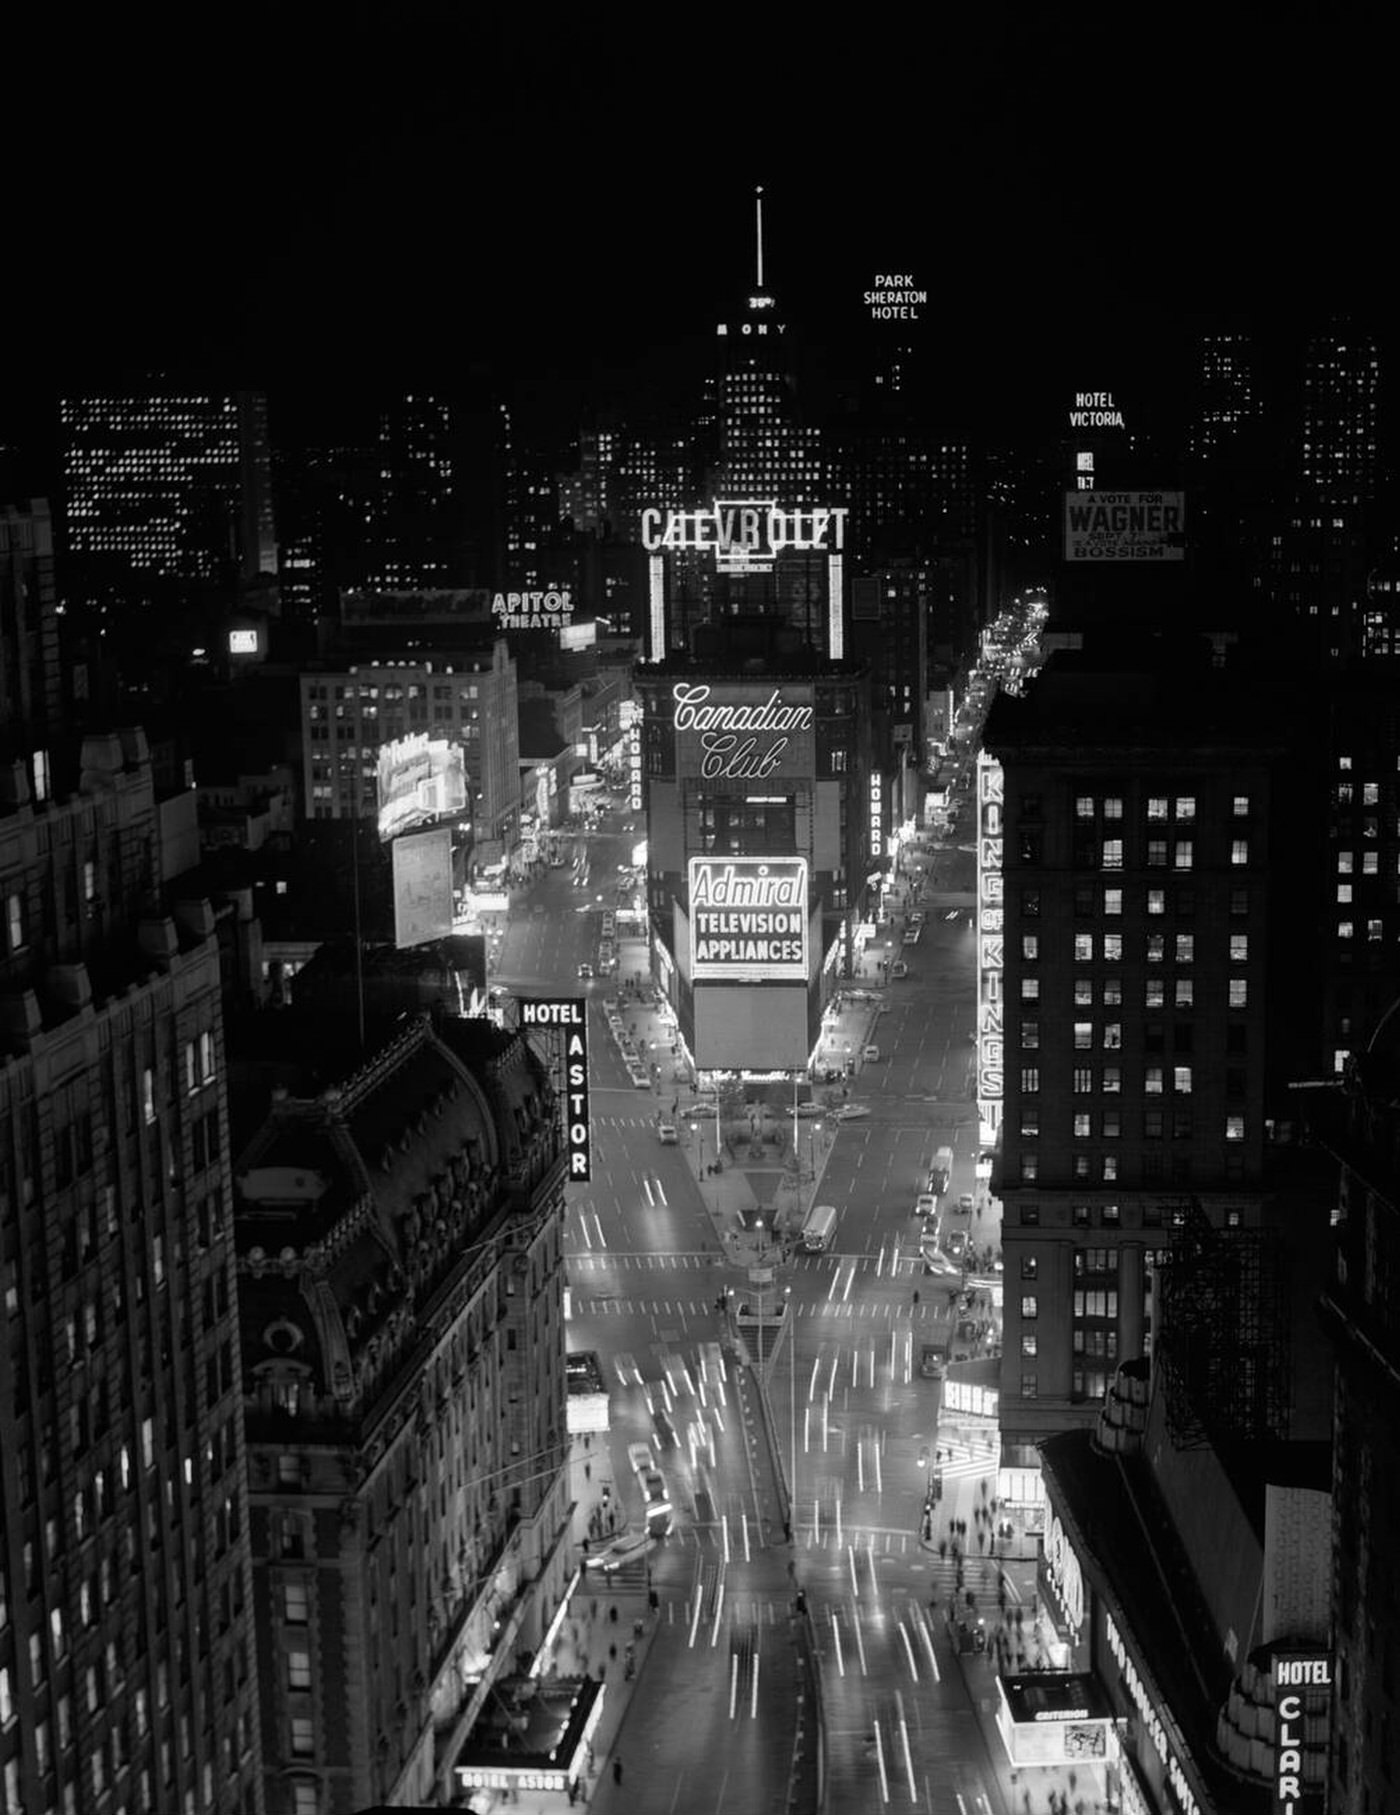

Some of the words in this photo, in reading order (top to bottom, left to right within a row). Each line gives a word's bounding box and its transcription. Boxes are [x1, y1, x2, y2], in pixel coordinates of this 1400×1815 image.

[875, 275, 914, 287] PARK
[863, 290, 927, 304] SHERATON
[871, 306, 919, 319] HOTEL
[717, 324, 786, 335] MONY
[1076, 392, 1115, 407] HOTEL
[1069, 411, 1125, 430] VICTORIA
[1088, 494, 1097, 504] A
[1100, 494, 1131, 504] VOTE
[1139, 494, 1163, 504] FOR
[641, 508, 849, 551] CHEVROLET
[1069, 505, 1180, 532] WAGNER
[1074, 547, 1165, 558] BOSSISM
[673, 683, 813, 730] Canadian
[701, 732, 788, 779] Club
[630, 728, 642, 810] HOWARD
[870, 773, 882, 856] HOWARD
[691, 864, 806, 907] Admiral
[697, 912, 802, 934] TELEVISION
[697, 939, 803, 961] APPLIANCES
[523, 1004, 582, 1023] HOTEL
[568, 1034, 587, 1174] ASTOR
[1277, 1660, 1332, 1685] HOTEL
[461, 1773, 509, 1787] HOTEL
[517, 1775, 565, 1790] ASTOR
